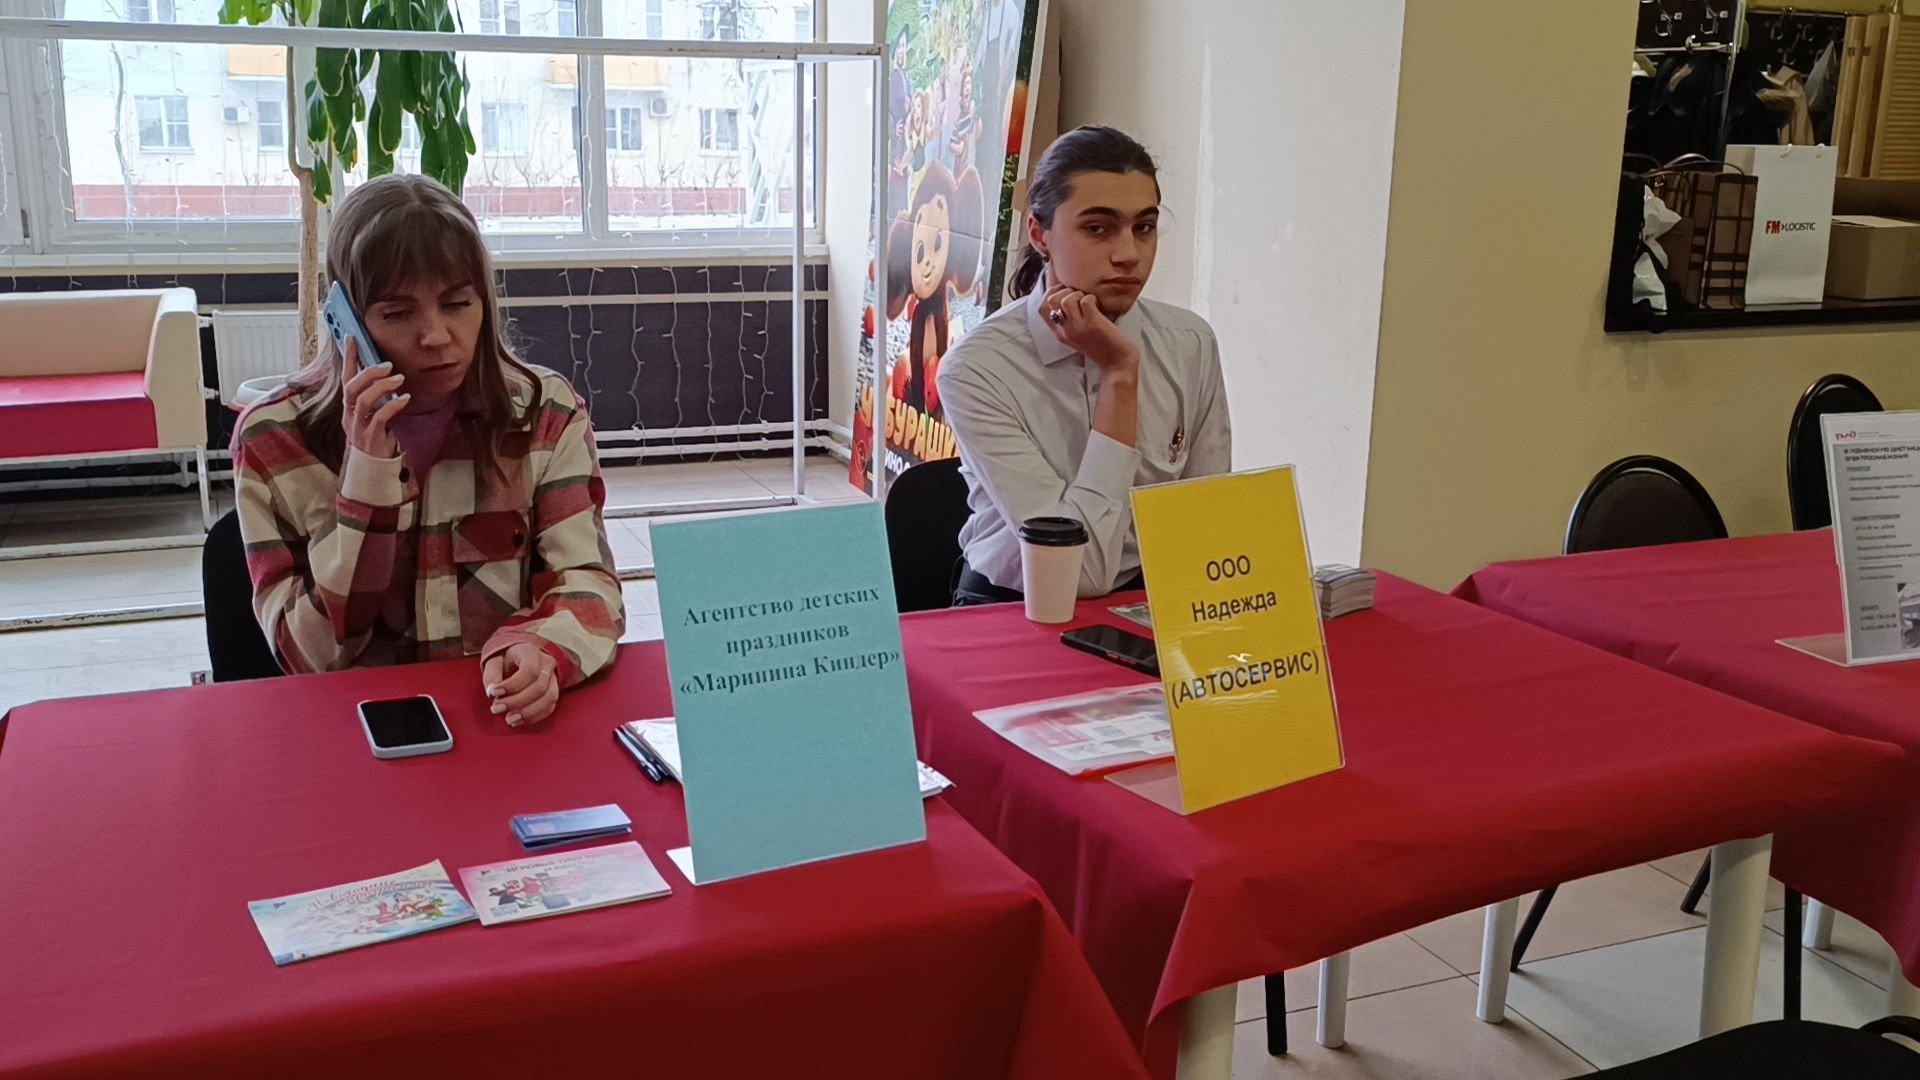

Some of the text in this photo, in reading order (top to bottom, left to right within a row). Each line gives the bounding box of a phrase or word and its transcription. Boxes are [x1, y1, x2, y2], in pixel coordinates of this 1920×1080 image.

[1206, 555, 1251, 581] ООО
[684, 587, 880, 626] Агентство детских
[1192, 591, 1277, 622] Надежда
[726, 624, 850, 657] праздников
[813, 650, 900, 676] Киндер»
[1172, 650, 1319, 709] (АВТОСЕРВИС)
